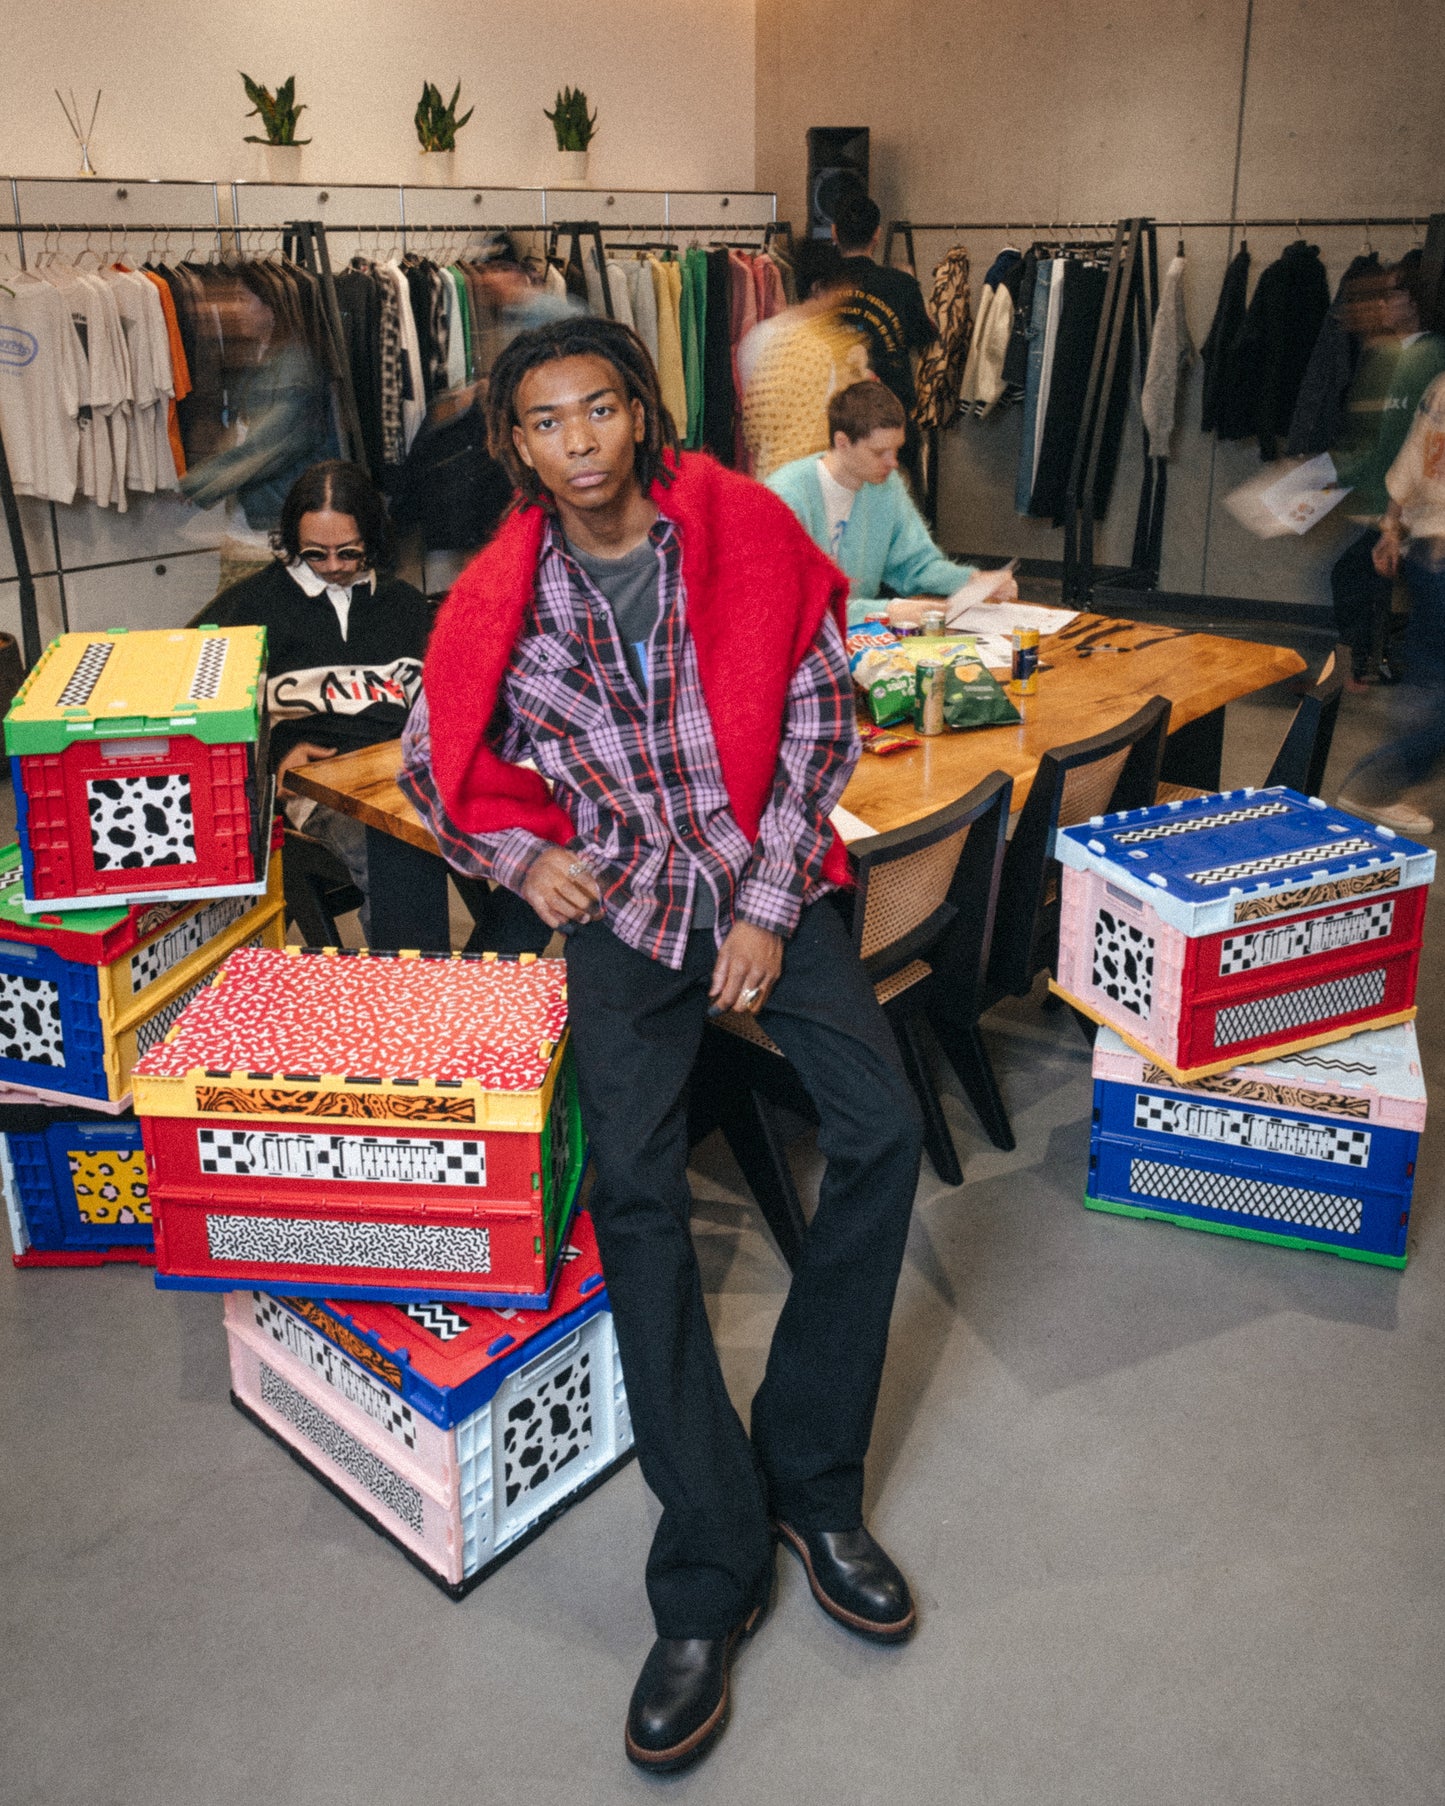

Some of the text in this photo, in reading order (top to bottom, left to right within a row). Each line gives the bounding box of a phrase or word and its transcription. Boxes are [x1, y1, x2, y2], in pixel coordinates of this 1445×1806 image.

[1250, 927, 1297, 962] SAINT
[1172, 1102, 1232, 1141] SAINT
[243, 1133, 318, 1177] SAINT
[276, 1310, 316, 1370] SAINT
